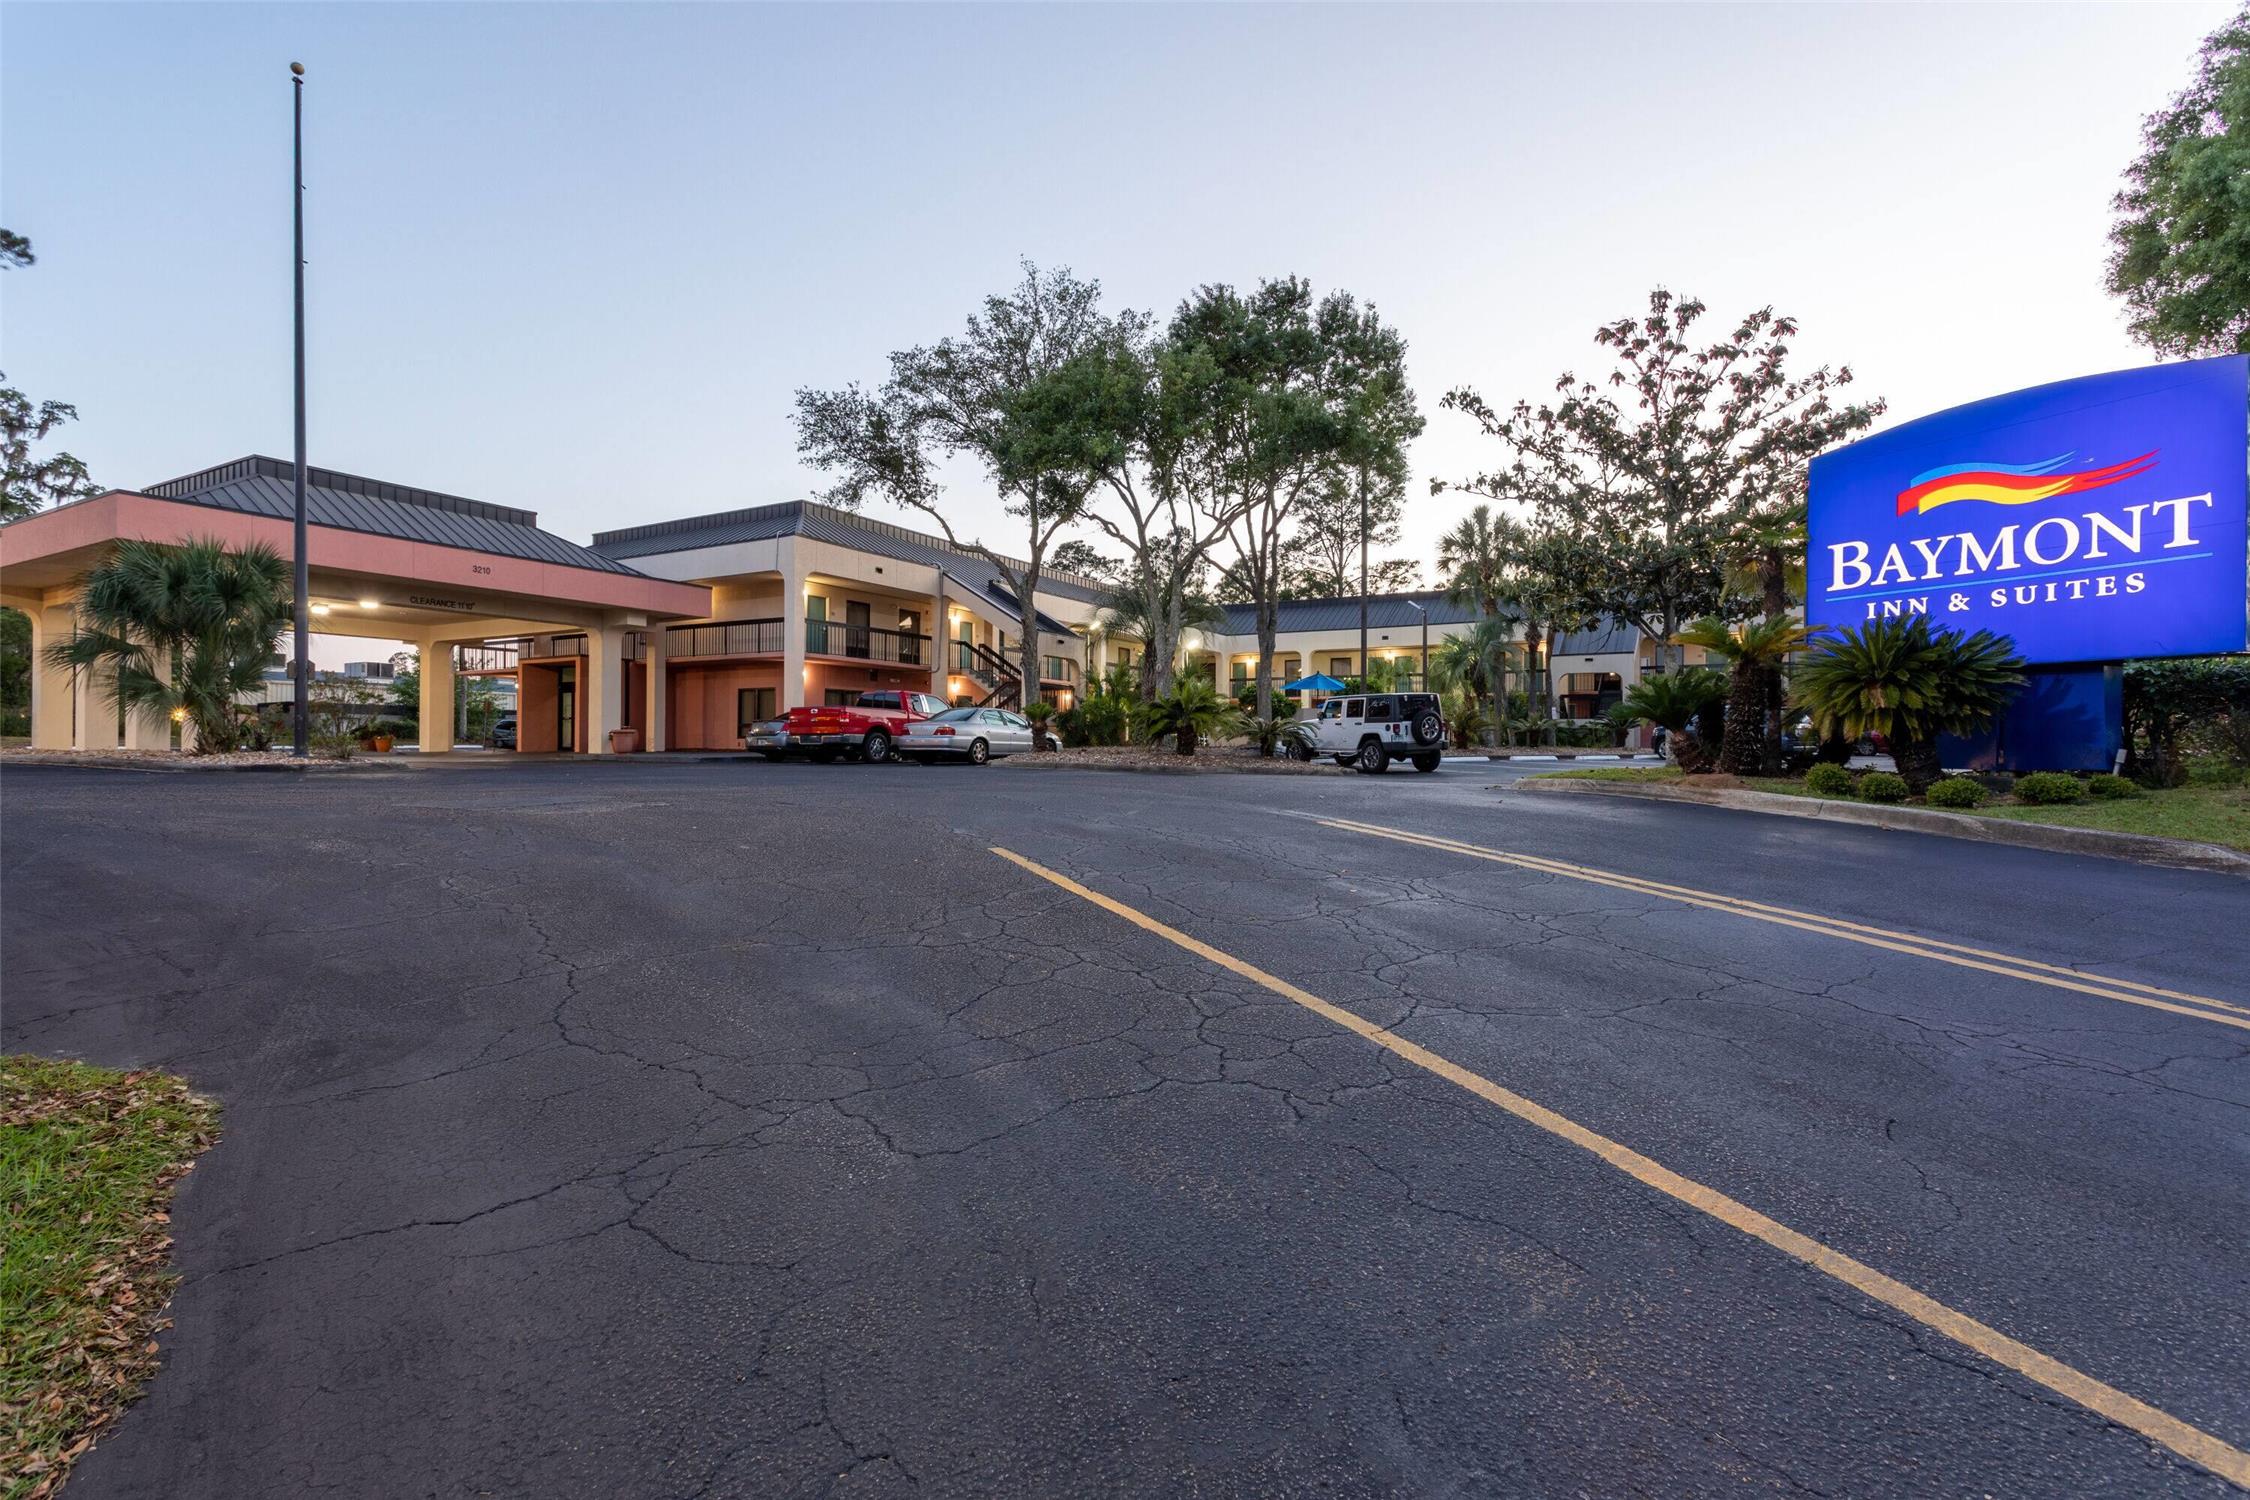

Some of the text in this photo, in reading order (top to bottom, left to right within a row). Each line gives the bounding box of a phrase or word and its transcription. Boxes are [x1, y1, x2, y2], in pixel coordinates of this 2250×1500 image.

[1826, 492, 2213, 592] BAYMONT
[472, 565, 491, 575] 3210
[409, 595, 456, 609] CLEARANCE
[1866, 572, 2146, 619] INN & SUITES
